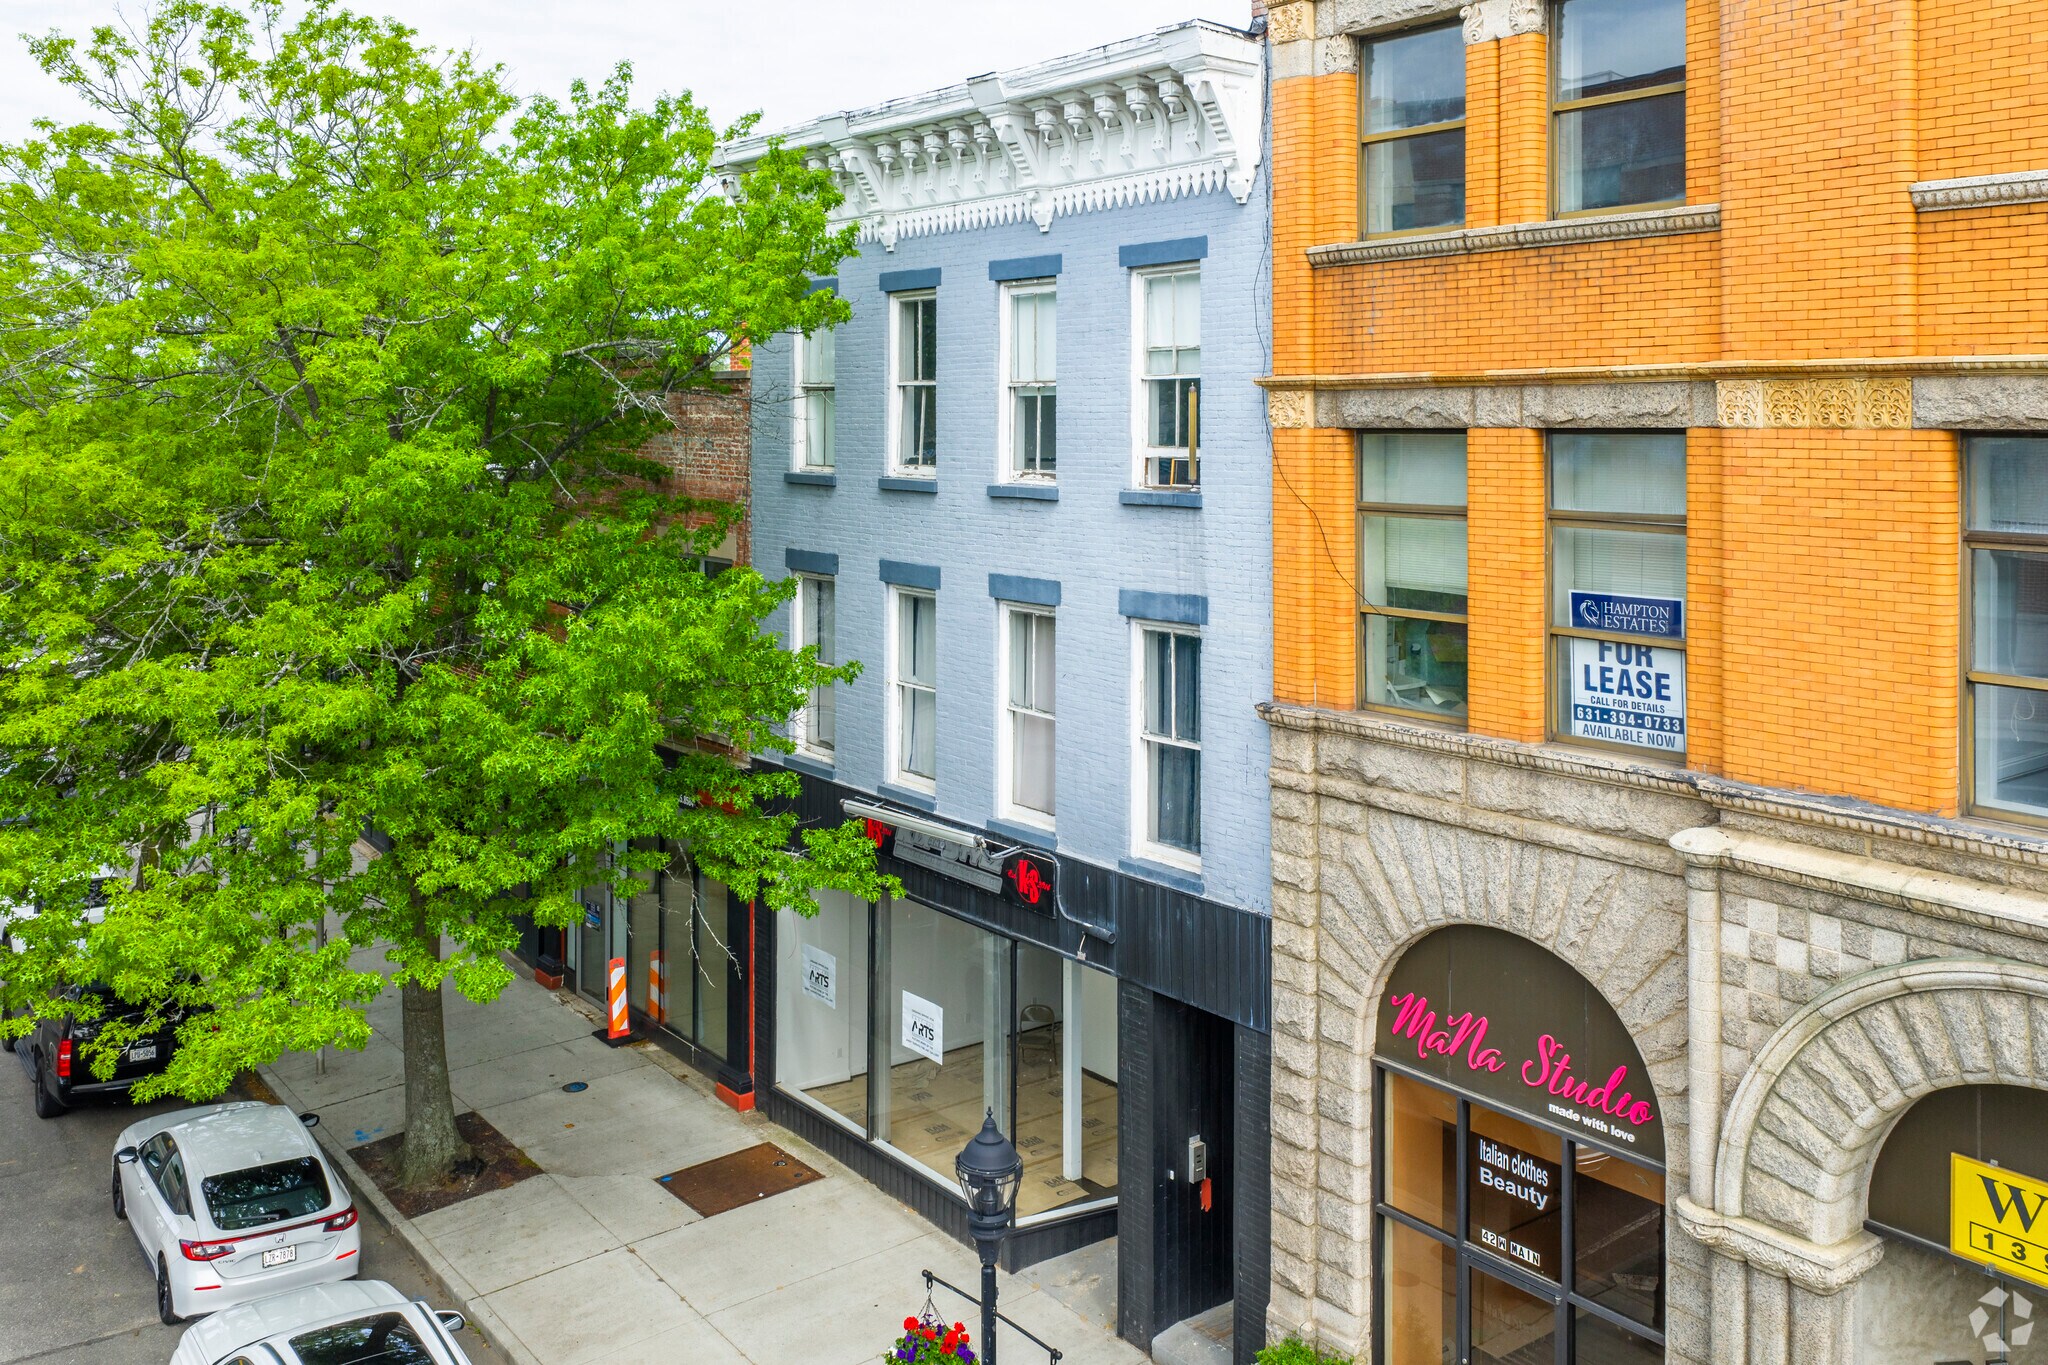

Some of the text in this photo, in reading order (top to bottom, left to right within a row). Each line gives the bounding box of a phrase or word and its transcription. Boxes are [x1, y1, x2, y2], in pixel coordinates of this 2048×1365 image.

[1604, 602, 1669, 619] HAMPTON
[1604, 615, 1666, 634] ESTATES
[1599, 641, 1653, 668] FOR
[1584, 664, 1671, 701] LEASE
[1590, 695, 1665, 714] CALL FOR DETAILS
[1577, 707, 1680, 732] 631-394-0733
[1583, 723, 1676, 748] AVAILABLE NOW
[809, 969, 829, 988] ARTS
[911, 1020, 934, 1041] ARTS
[1391, 992, 1654, 1125] MaNa Studio
[1548, 1103, 1635, 1143] made with love
[1479, 1138, 1548, 1187] Italian clothes
[1479, 1167, 1548, 1210] Beauty
[264, 1248, 294, 1264] LZR-7878
[1482, 1229, 1540, 1266] 42 W MAIN
[1983, 1233, 2048, 1270] 13
